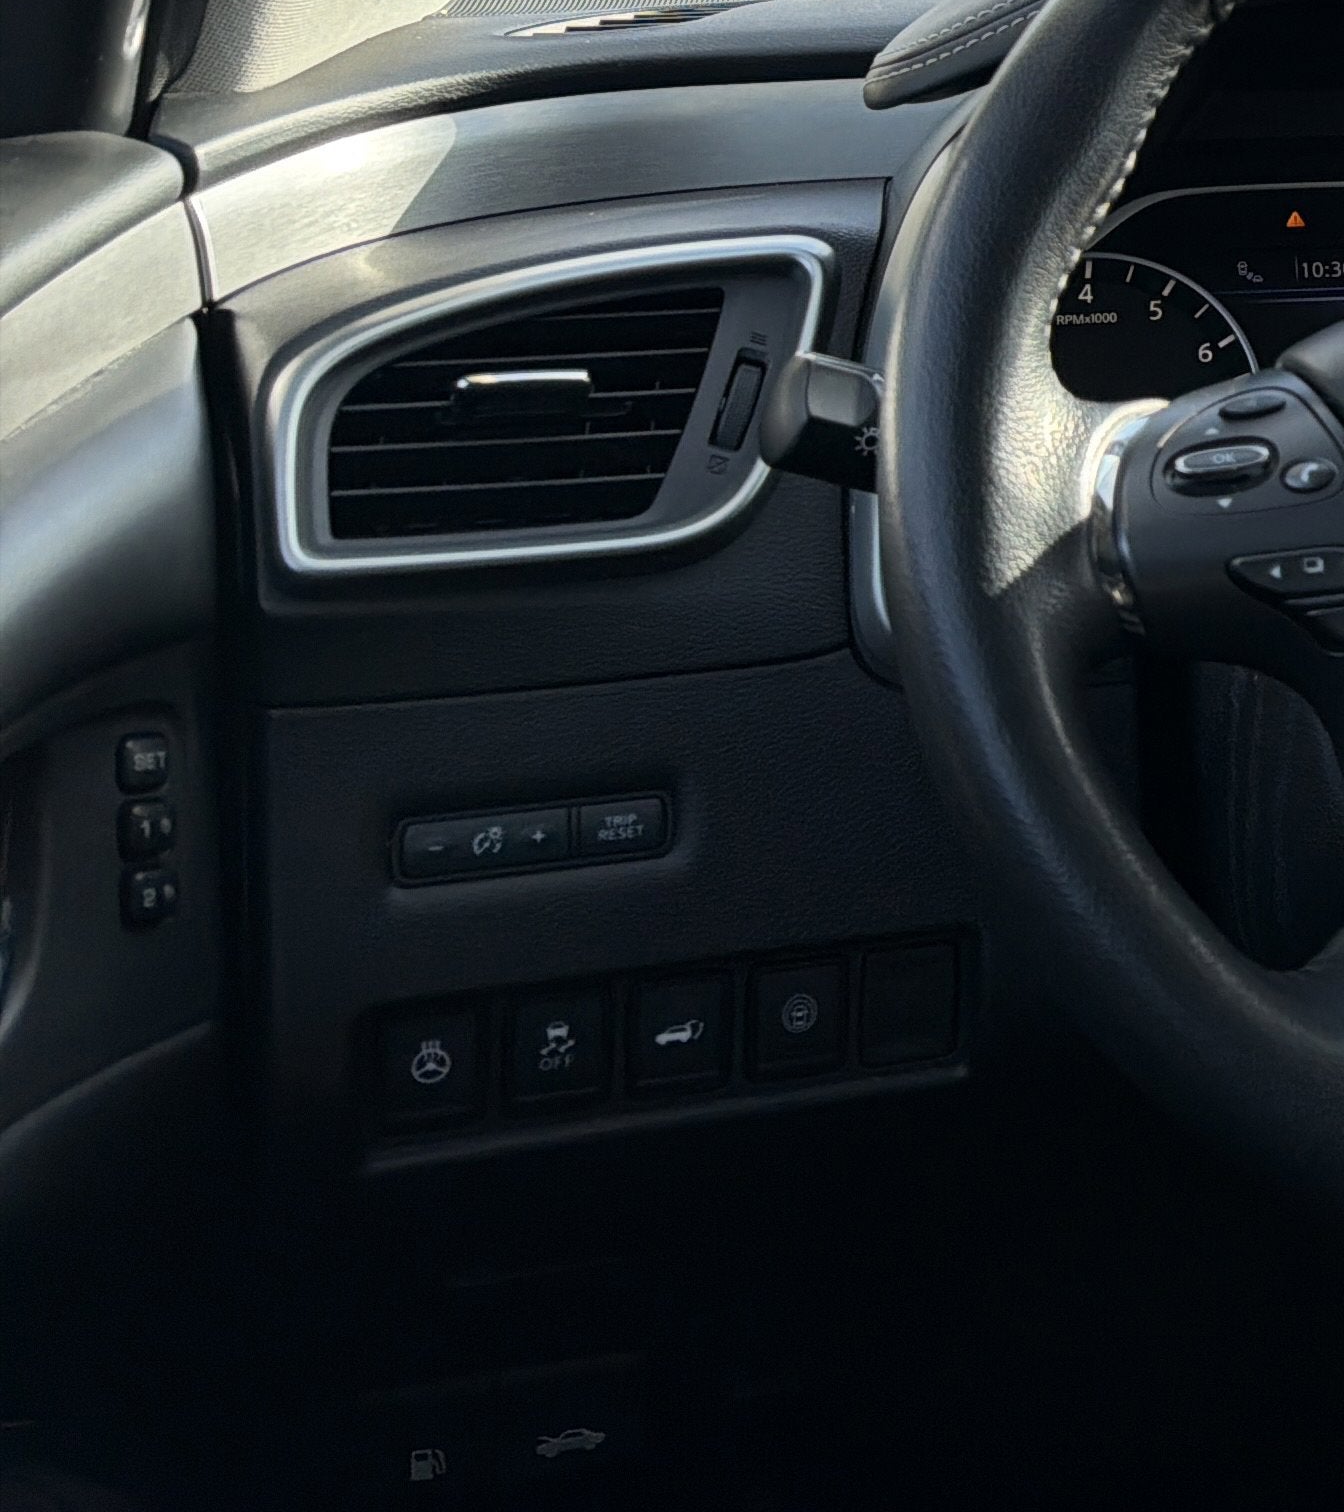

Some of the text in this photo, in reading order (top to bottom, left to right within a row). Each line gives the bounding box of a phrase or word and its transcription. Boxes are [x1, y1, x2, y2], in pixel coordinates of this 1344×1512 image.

[1078, 284, 1093, 303] 4
[1056, 312, 1118, 325] RPMx1000
[1149, 300, 1163, 321] 5
[1198, 342, 1213, 363] 6
[1213, 454, 1235, 464] OK
[134, 752, 166, 772] SET
[140, 820, 151, 837] 1
[605, 814, 638, 828] TRIP
[597, 824, 643, 841] RESET
[143, 891, 156, 907] 2
[538, 1054, 574, 1071] OFF
